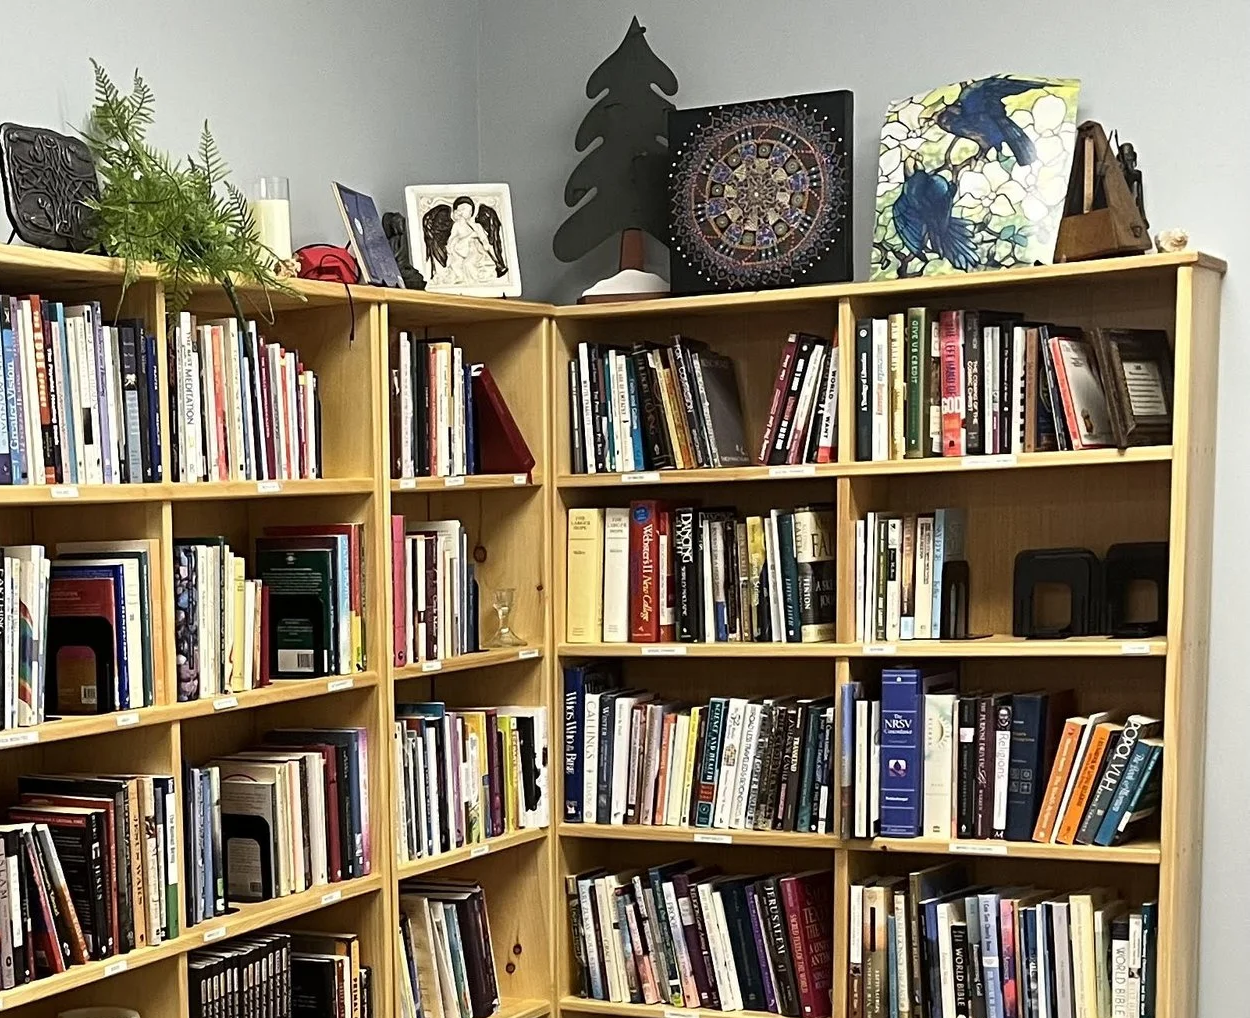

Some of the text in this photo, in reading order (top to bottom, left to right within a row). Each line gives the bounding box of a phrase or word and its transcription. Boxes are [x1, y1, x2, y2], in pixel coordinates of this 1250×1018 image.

[185, 369, 194, 425] MEDITATION
[823, 370, 837, 439] WORLD WANT
[642, 524, 653, 565] Webster's
[640, 595, 652, 622] College
[642, 575, 652, 594] New
[585, 701, 596, 760] CALLINGS
[884, 719, 912, 728] NRSV
[997, 733, 1009, 780] Religions
[1099, 722, 1143, 791] POPOL VUH
[93, 864, 102, 901] JESUS
[133, 815, 144, 906] JESUS WARS
[764, 886, 786, 955] JERUSALEM
[955, 948, 965, 1006] WORLD BIBLE
[1114, 947, 1126, 1016] WORLD BIBLE
